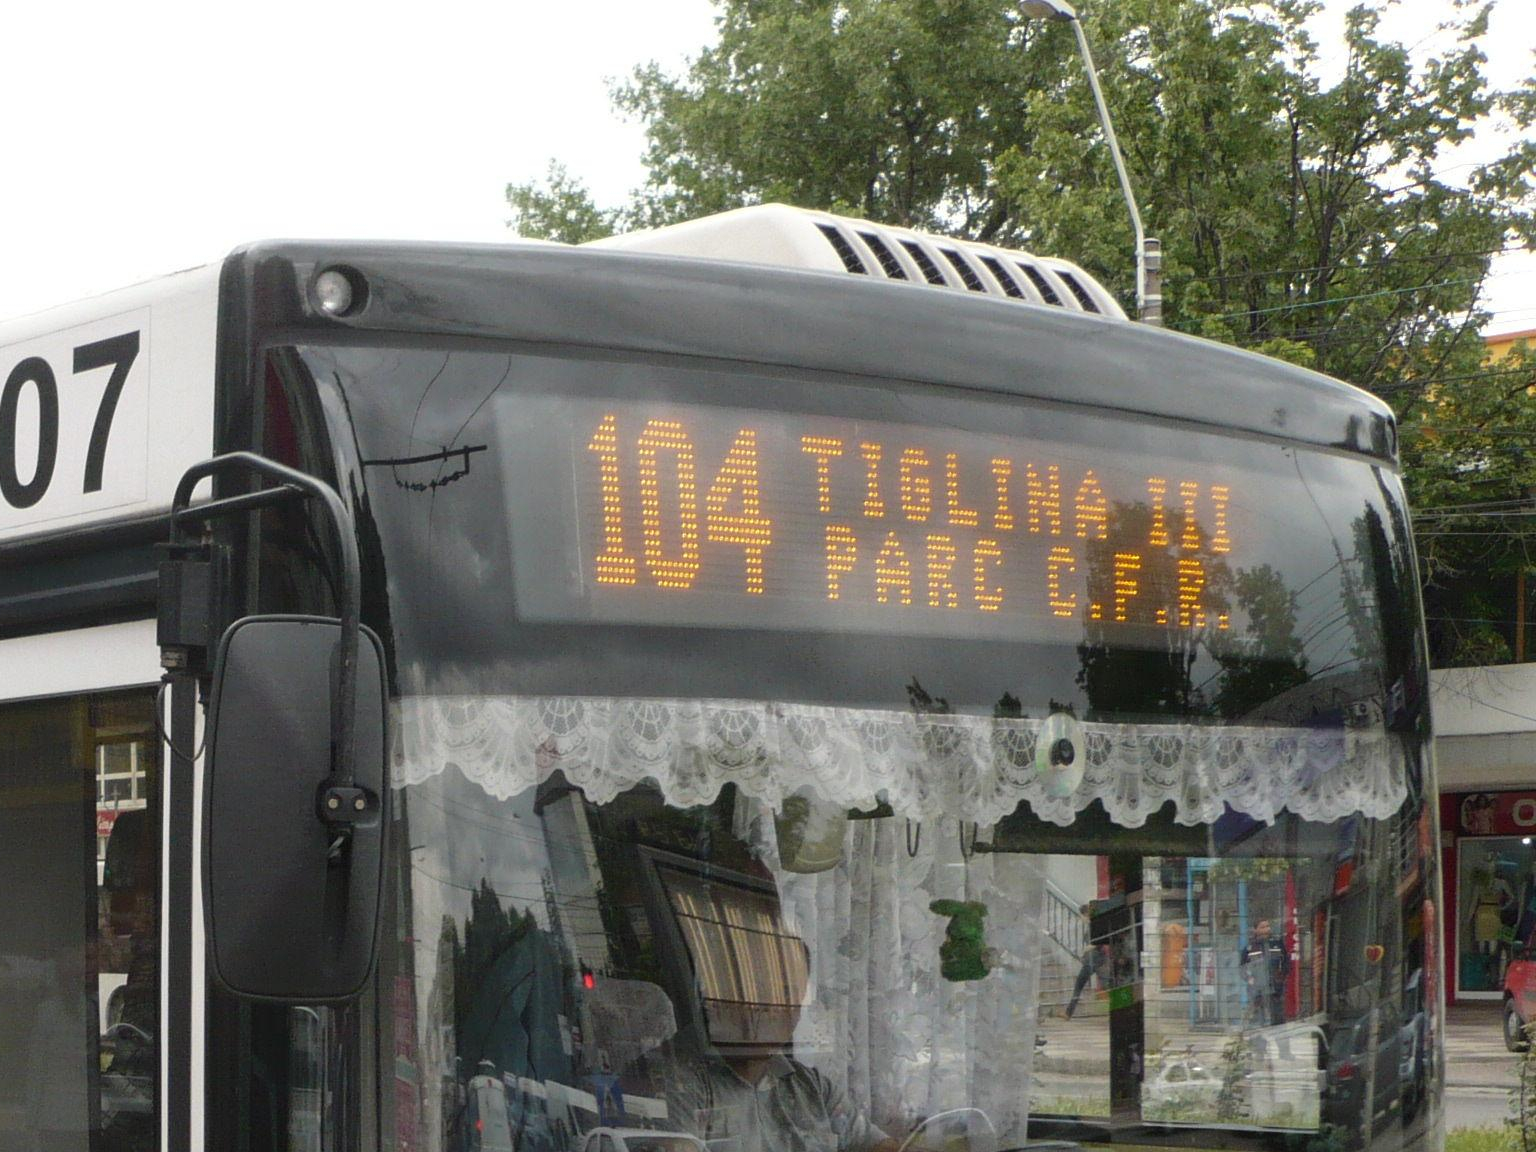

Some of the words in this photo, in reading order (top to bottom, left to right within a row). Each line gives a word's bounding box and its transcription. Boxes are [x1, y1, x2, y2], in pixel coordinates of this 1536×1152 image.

[588, 414, 771, 594] 104
[800, 435, 1108, 540] TIGLINA
[1147, 476, 1231, 553] III
[825, 524, 1005, 612] PARC
